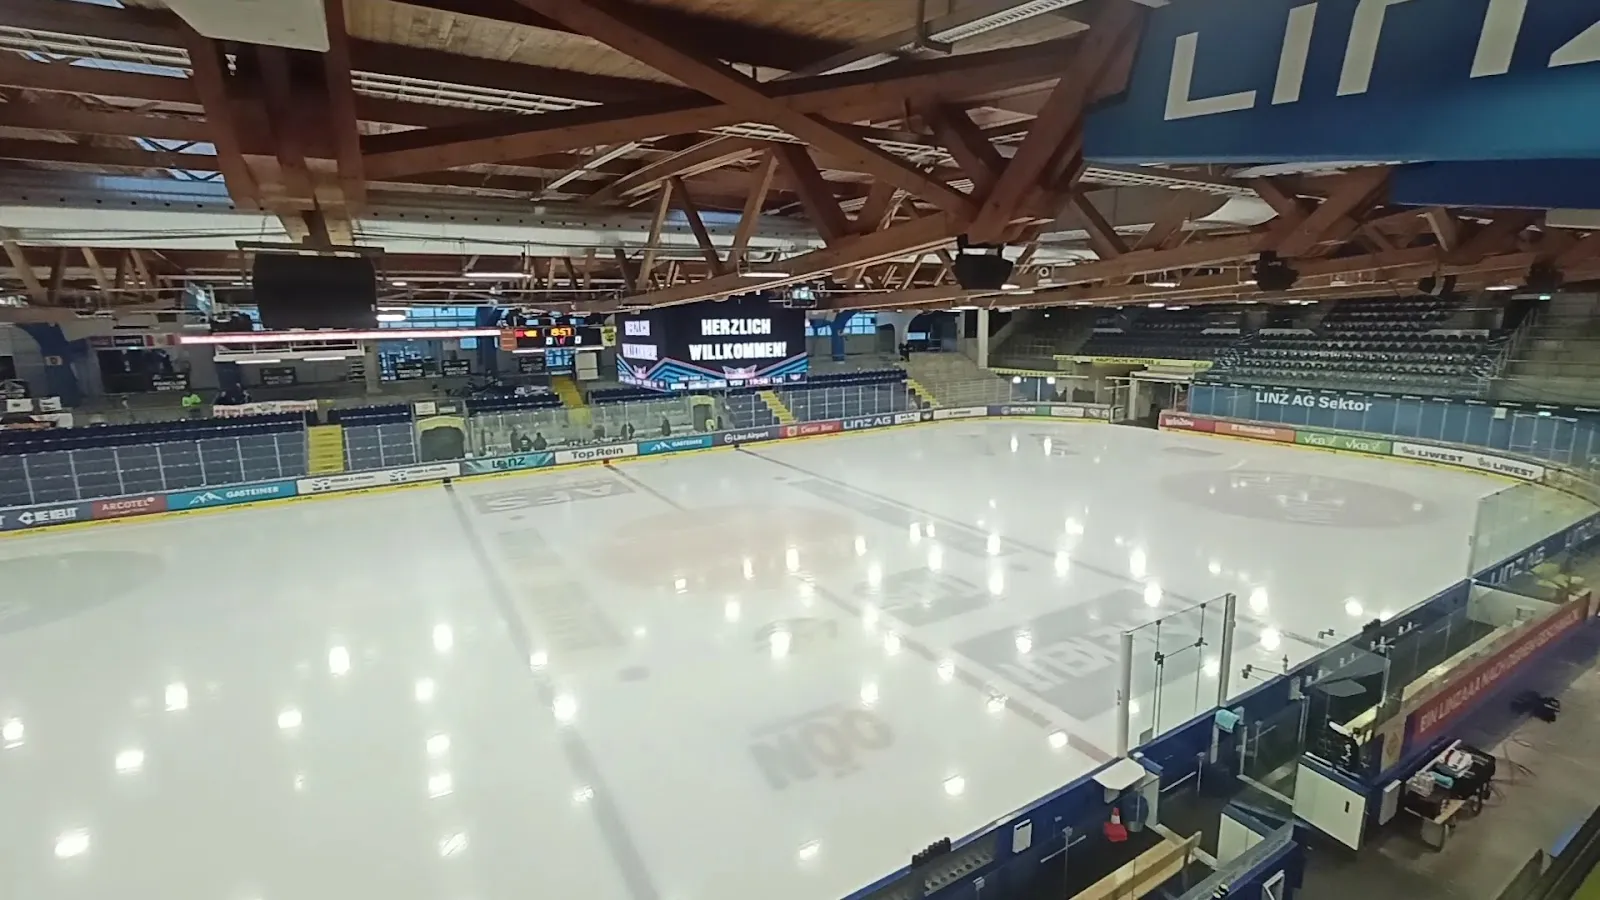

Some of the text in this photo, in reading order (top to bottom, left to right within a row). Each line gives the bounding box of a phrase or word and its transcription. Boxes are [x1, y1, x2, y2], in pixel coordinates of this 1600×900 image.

[1164, 0, 1600, 120] LIN
[701, 318, 771, 336] HERZLICH
[688, 341, 787, 361] WILLKOMMEN!
[1255, 391, 1373, 412] LINZ AG Sektor
[874, 416, 891, 425] AG
[747, 431, 769, 440] Airport
[571, 447, 624, 460] Top Rein
[1418, 450, 1535, 478] LIWEST LIWEST
[225, 486, 279, 499] GASTEINER
[102, 500, 150, 511] ARCOTEL
